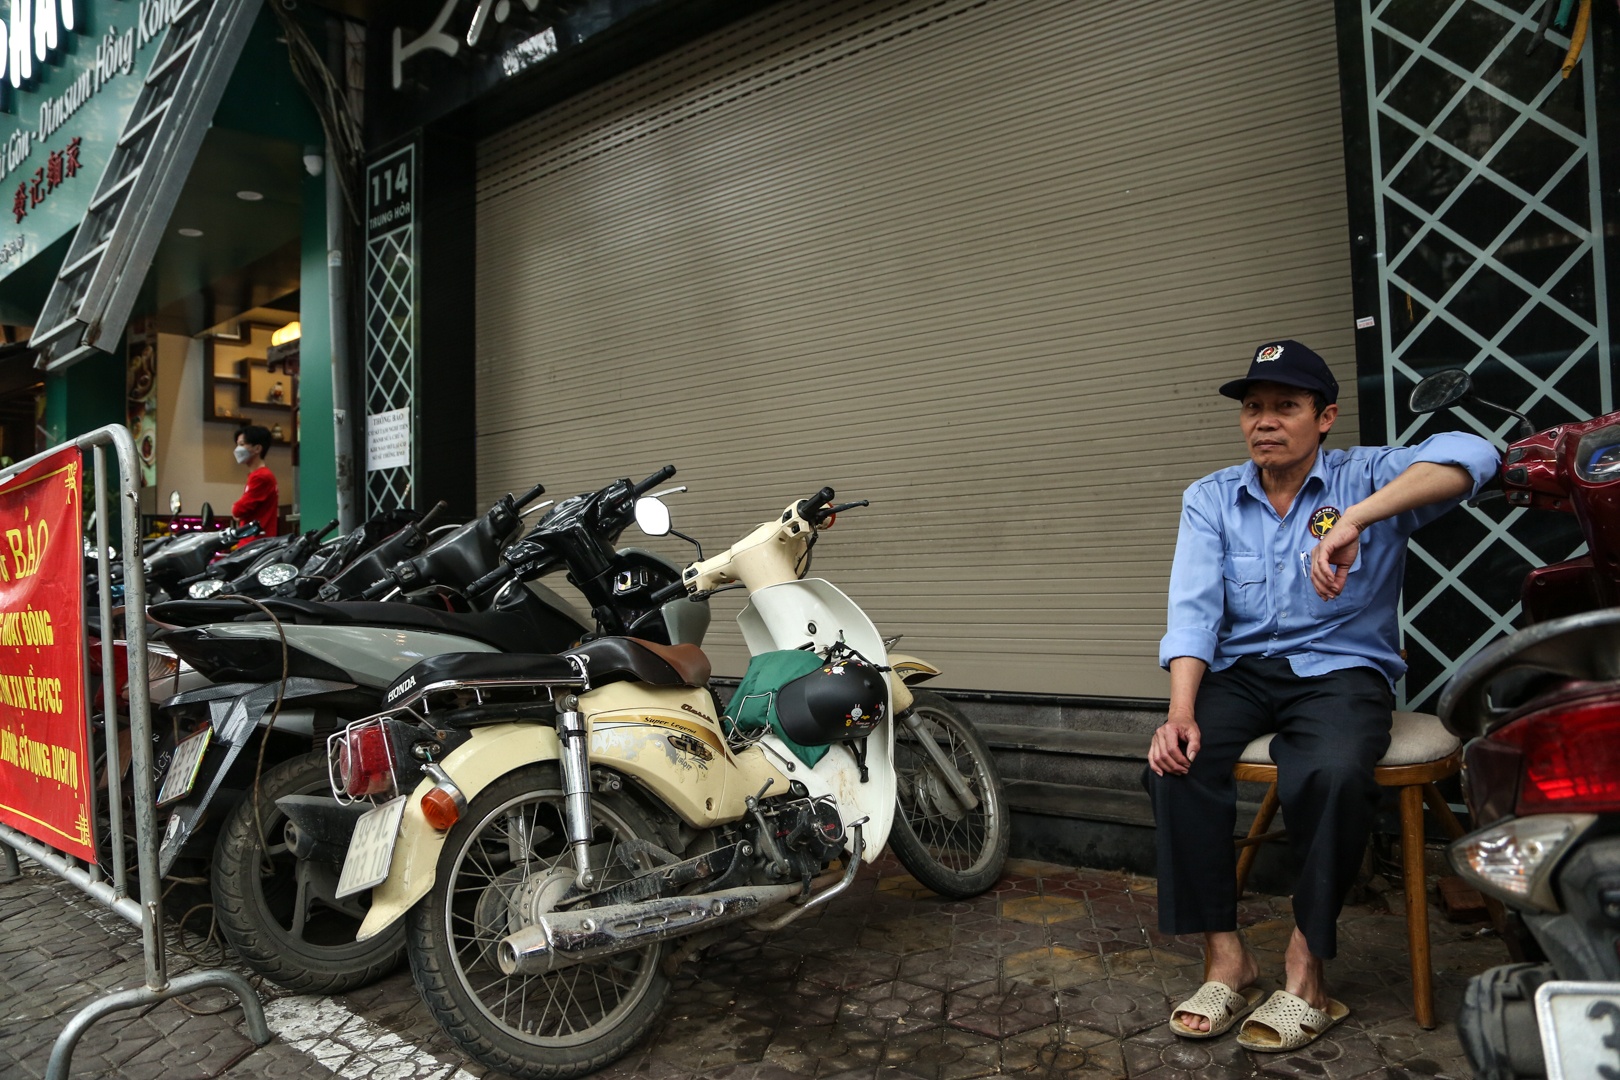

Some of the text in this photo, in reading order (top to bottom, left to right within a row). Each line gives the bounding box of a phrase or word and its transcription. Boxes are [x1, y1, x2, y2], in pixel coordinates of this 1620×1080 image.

[8, 129, 30, 172] Gòn
[39, 69, 90, 142] Dimsum
[94, 25, 134, 92] Hồng
[372, 162, 408, 206] 114
[369, 201, 410, 230] TRUNG HÒA
[6, 506, 49, 580] BÁO
[3, 612, 23, 654] HOẠT
[21, 603, 54, 654] ĐỘNG
[24, 664, 38, 711] VỀ
[37, 677, 63, 715] PCCC
[387, 675, 417, 703] HONDA
[19, 723, 30, 771] SỬ
[28, 739, 52, 783] DỤNG
[51, 744, 70, 791] DỊCH
[355, 806, 395, 850] 99-AC
[341, 842, 390, 891] 003.10
